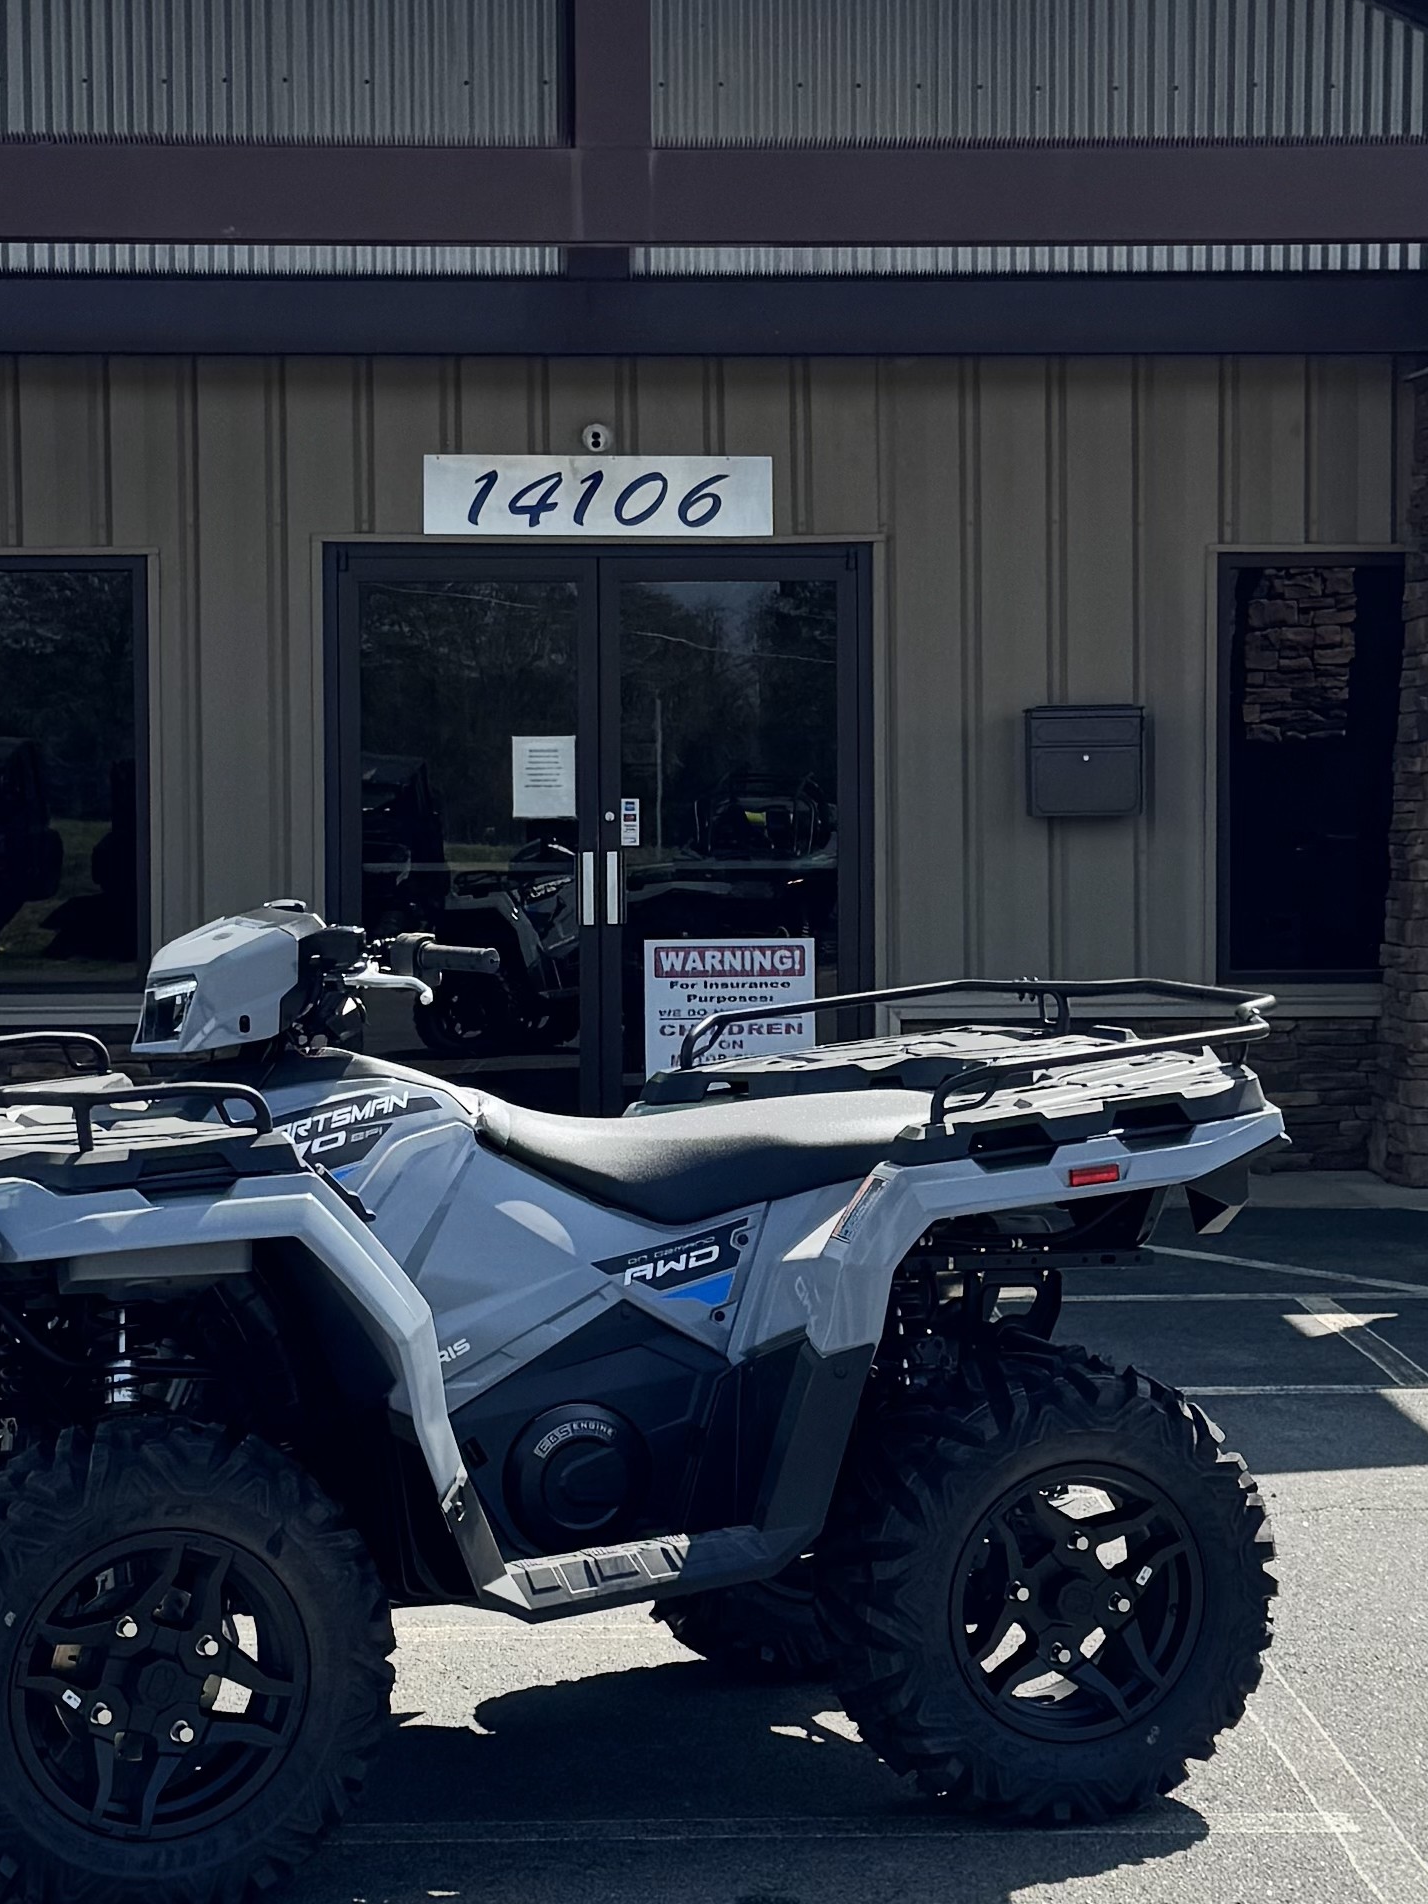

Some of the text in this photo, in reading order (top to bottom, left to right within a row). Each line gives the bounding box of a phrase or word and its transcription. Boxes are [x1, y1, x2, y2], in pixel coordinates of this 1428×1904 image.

[467, 469, 731, 528] 14106
[659, 949, 801, 972] WARNING!
[670, 980, 791, 990] For Insurance
[687, 994, 774, 1004] Purposes:
[658, 1008, 681, 1017] WE
[687, 1008, 708, 1017] DO
[718, 1039, 744, 1050] ON
[623, 1245, 720, 1286] AWD
